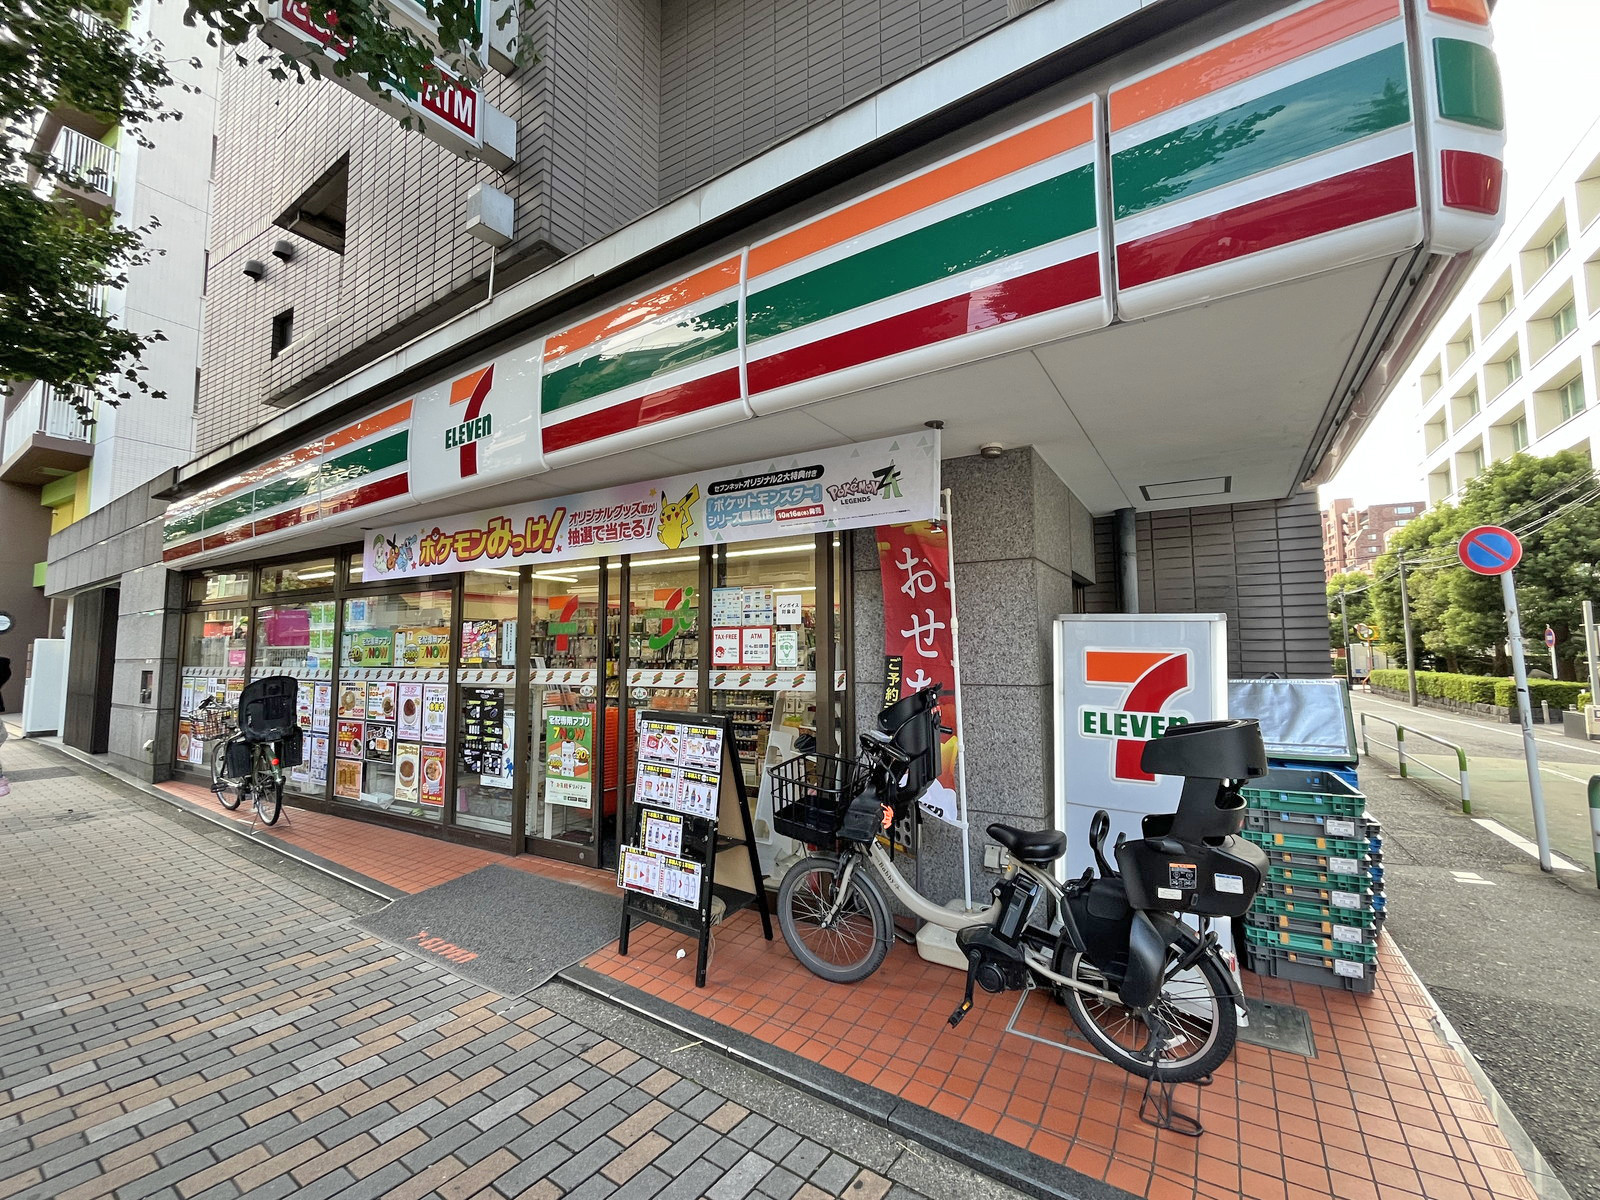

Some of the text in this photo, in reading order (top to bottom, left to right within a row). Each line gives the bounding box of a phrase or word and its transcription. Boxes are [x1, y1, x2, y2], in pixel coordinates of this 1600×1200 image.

[840, 496, 871, 505] LEGENDS
[708, 507, 771, 526] シリーズ最新作
[419, 507, 566, 567] ポケモンみっけ!
[568, 517, 654, 546] 抽選で当たる!
[553, 726, 586, 741] 7NOW
